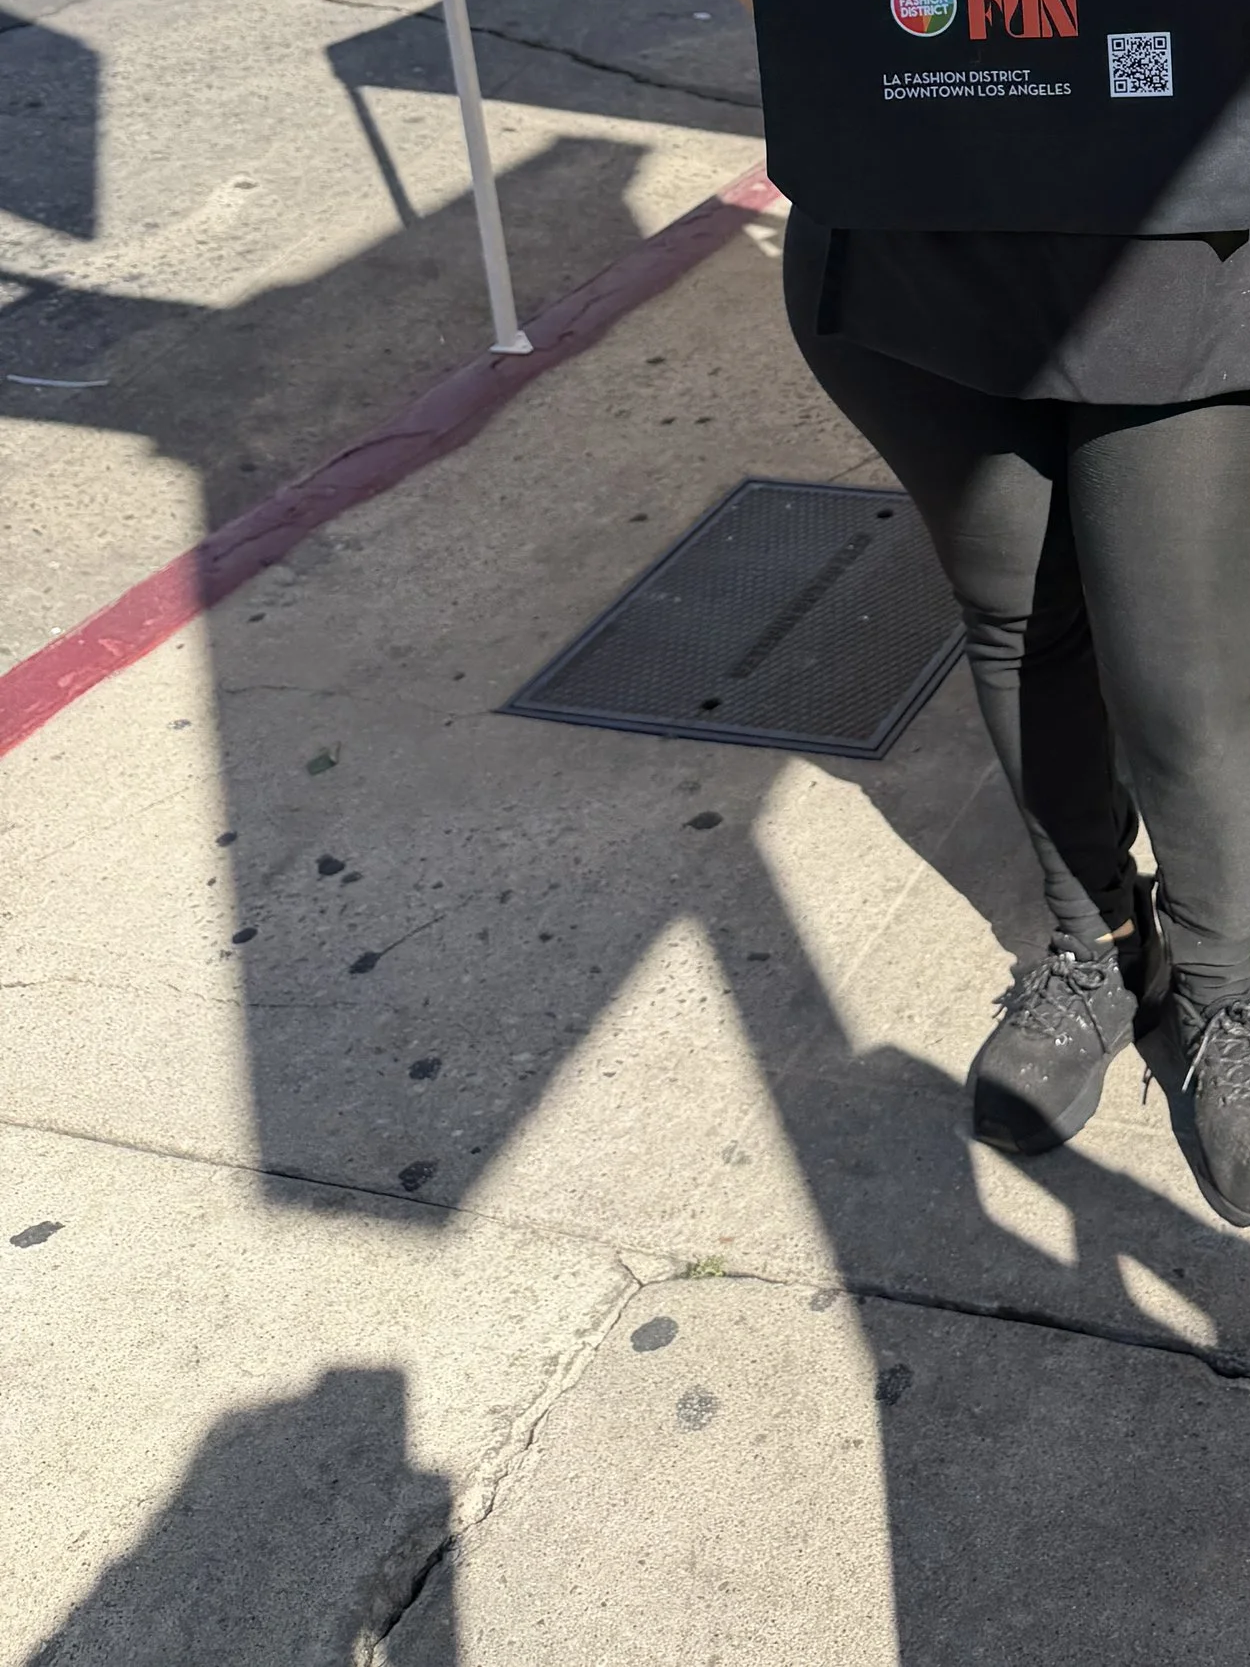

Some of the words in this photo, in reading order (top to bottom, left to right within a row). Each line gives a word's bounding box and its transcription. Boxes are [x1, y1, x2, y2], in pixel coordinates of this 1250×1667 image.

[899, 3, 949, 19] DISTRICT
[883, 74, 901, 87] LA
[904, 70, 966, 86] FASHION
[969, 69, 1031, 83] DISTRICT
[884, 85, 975, 101] DOWNTOWN
[978, 84, 1006, 98] LOS
[1008, 82, 1073, 97] ANGELES
